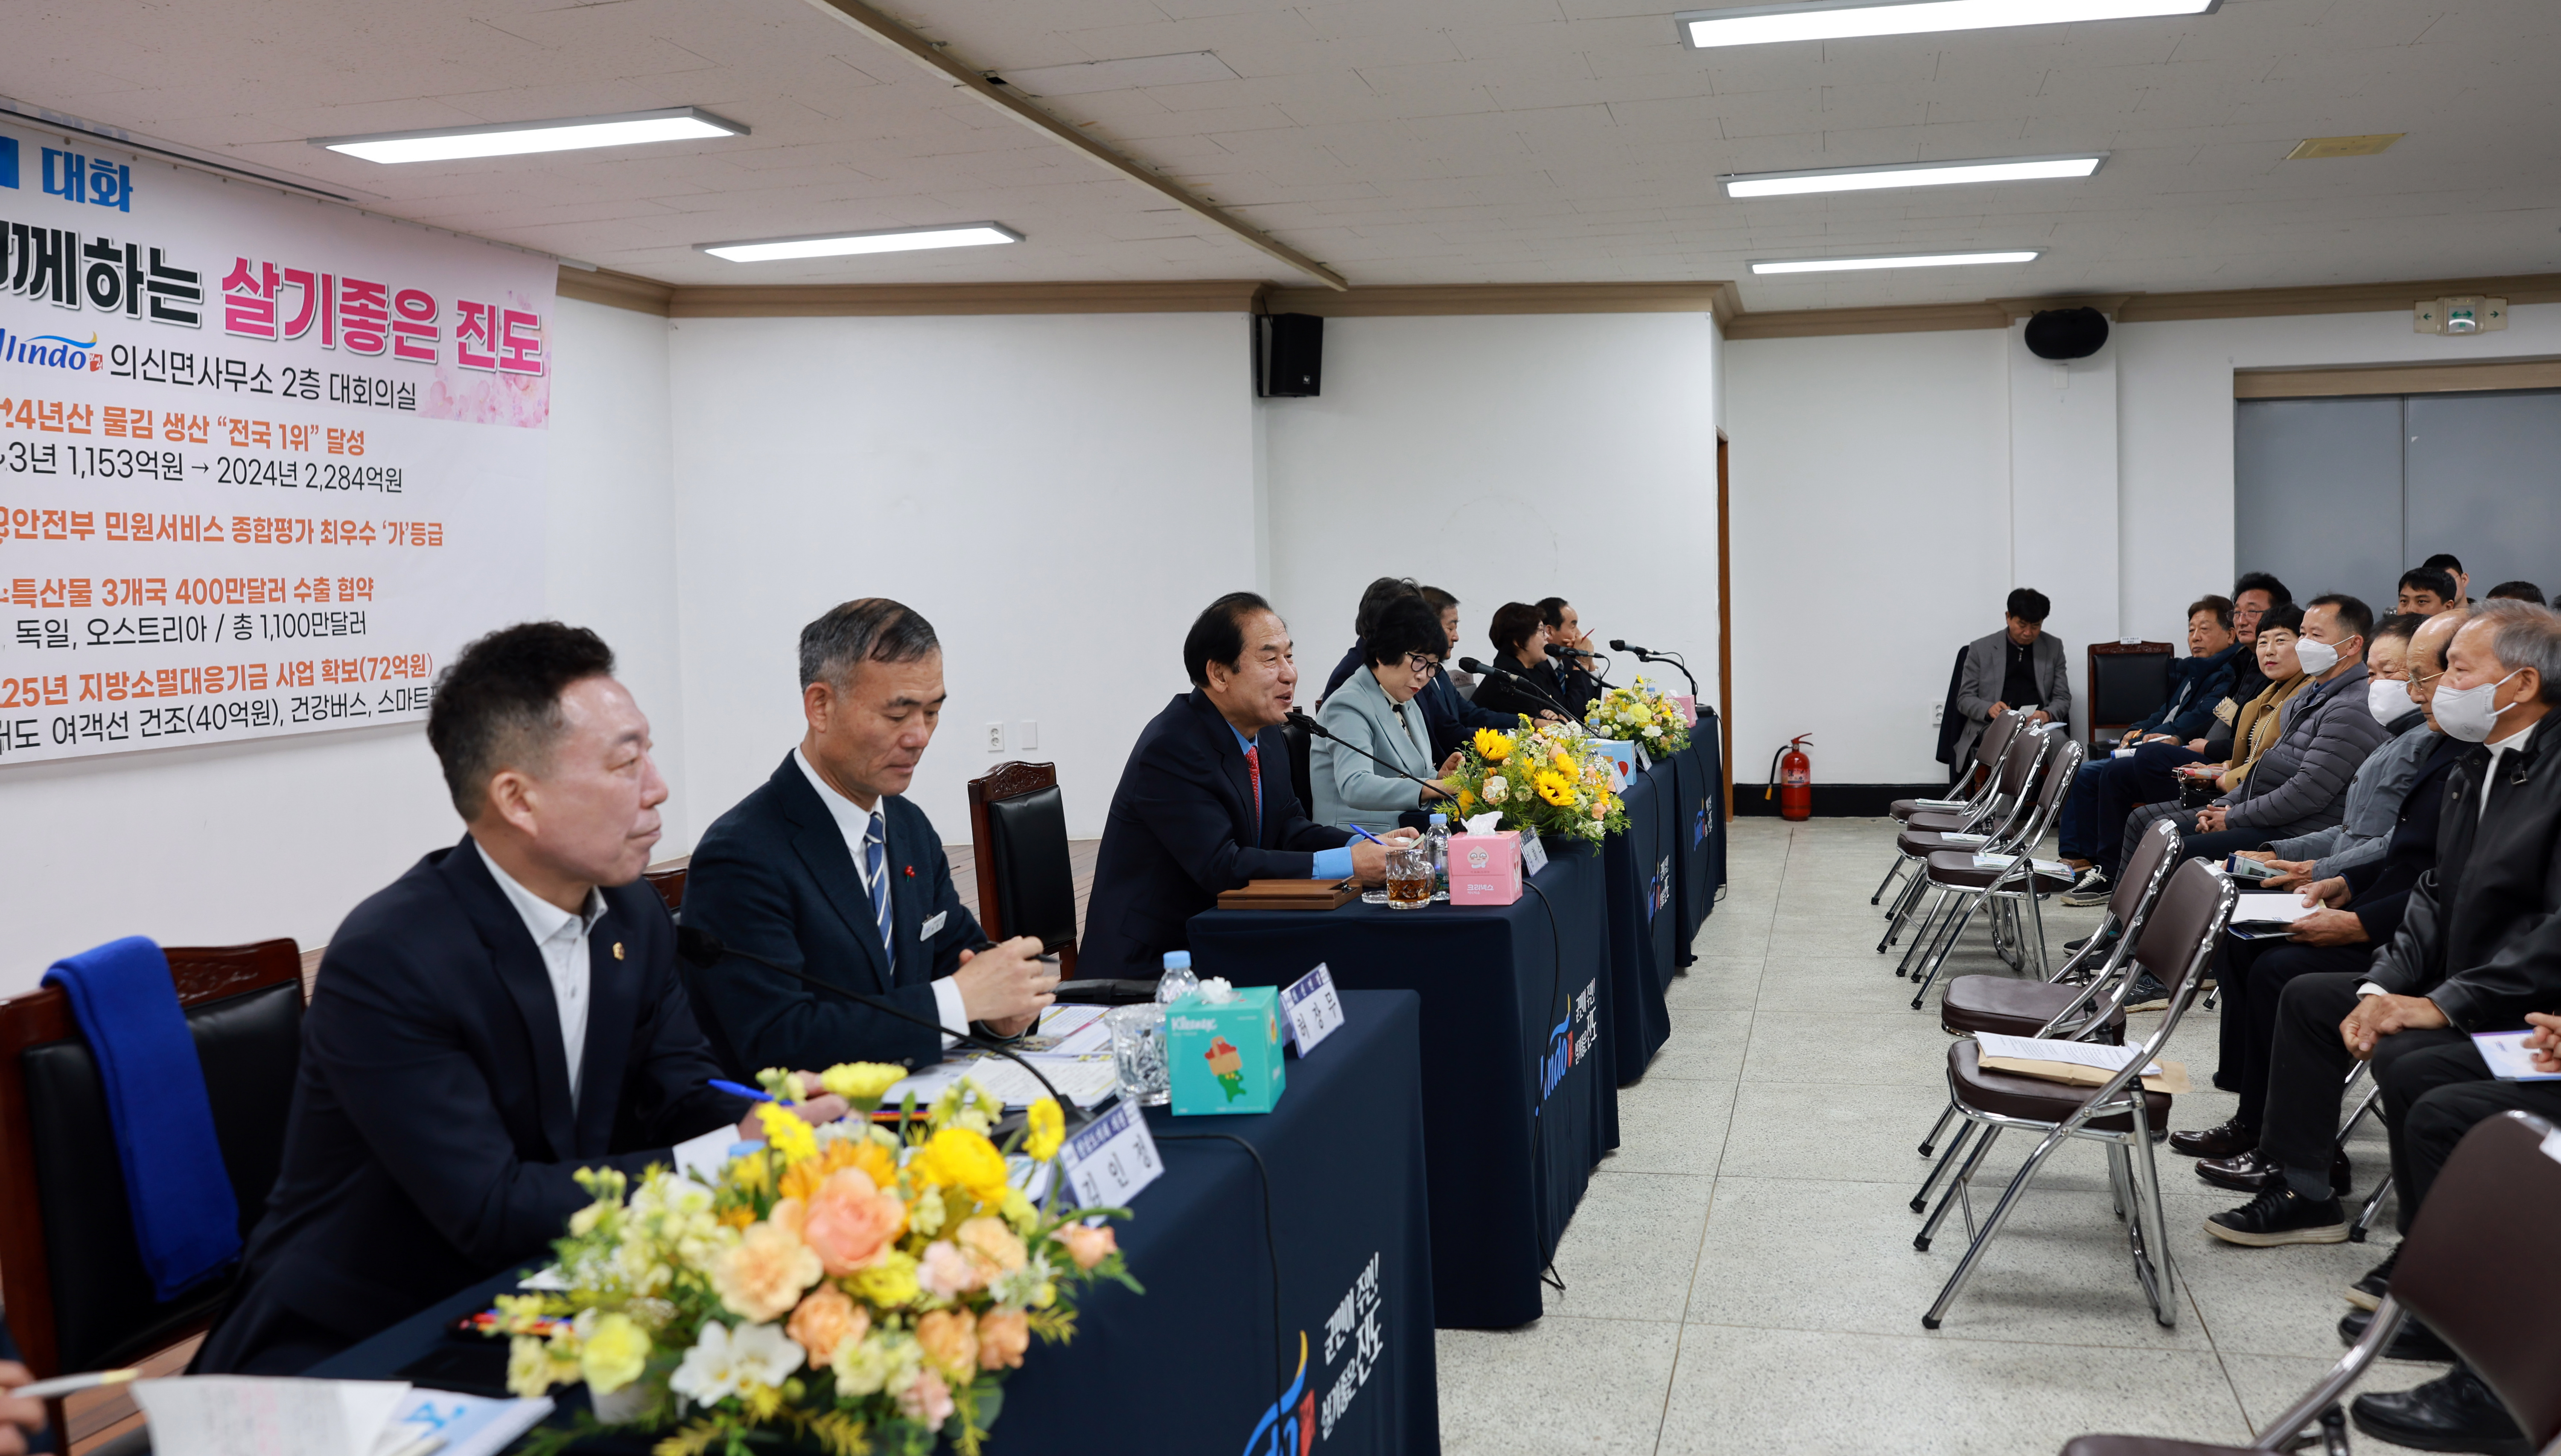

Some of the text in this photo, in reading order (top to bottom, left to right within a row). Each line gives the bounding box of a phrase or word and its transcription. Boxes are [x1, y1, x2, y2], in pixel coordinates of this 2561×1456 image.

[41, 146, 133, 213] 대화
[0, 220, 542, 373] 께하는 살기좋은 진도
[110, 344, 416, 411] 의신면사무소 2층 대회의실
[102, 405, 153, 440] 물김
[163, 412, 210, 444] 생산
[327, 428, 365, 456] 달성
[0, 442, 403, 493] 3년 1,153억원 2024년 2,284억원
[105, 511, 225, 542] 민원서비스
[232, 516, 314, 545] 종합평가
[321, 519, 376, 546] 최우수
[0, 577, 374, 608] 특산물 3개국 400만달러 수출 협약
[16, 618, 77, 650] 독일,
[87, 615, 207, 646] 오스트리아
[233, 613, 253, 641] 총
[260, 611, 367, 641] 1,100만달러
[79, 662, 268, 702] 지방소멸대응기금
[276, 660, 314, 688] 사업
[321, 652, 433, 684] 확보(72억원)
[53, 711, 129, 745] 여객선
[139, 698, 284, 738] 건조(40억원),
[291, 692, 371, 723] 건강버스,
[1576, 978, 1596, 1024] 군민이 주인!
[1575, 1006, 1597, 1065] 살기좋은 진도
[1324, 1251, 1379, 1366] 군민이 주인!
[1321, 1297, 1383, 1441] 살기좋은 진도
